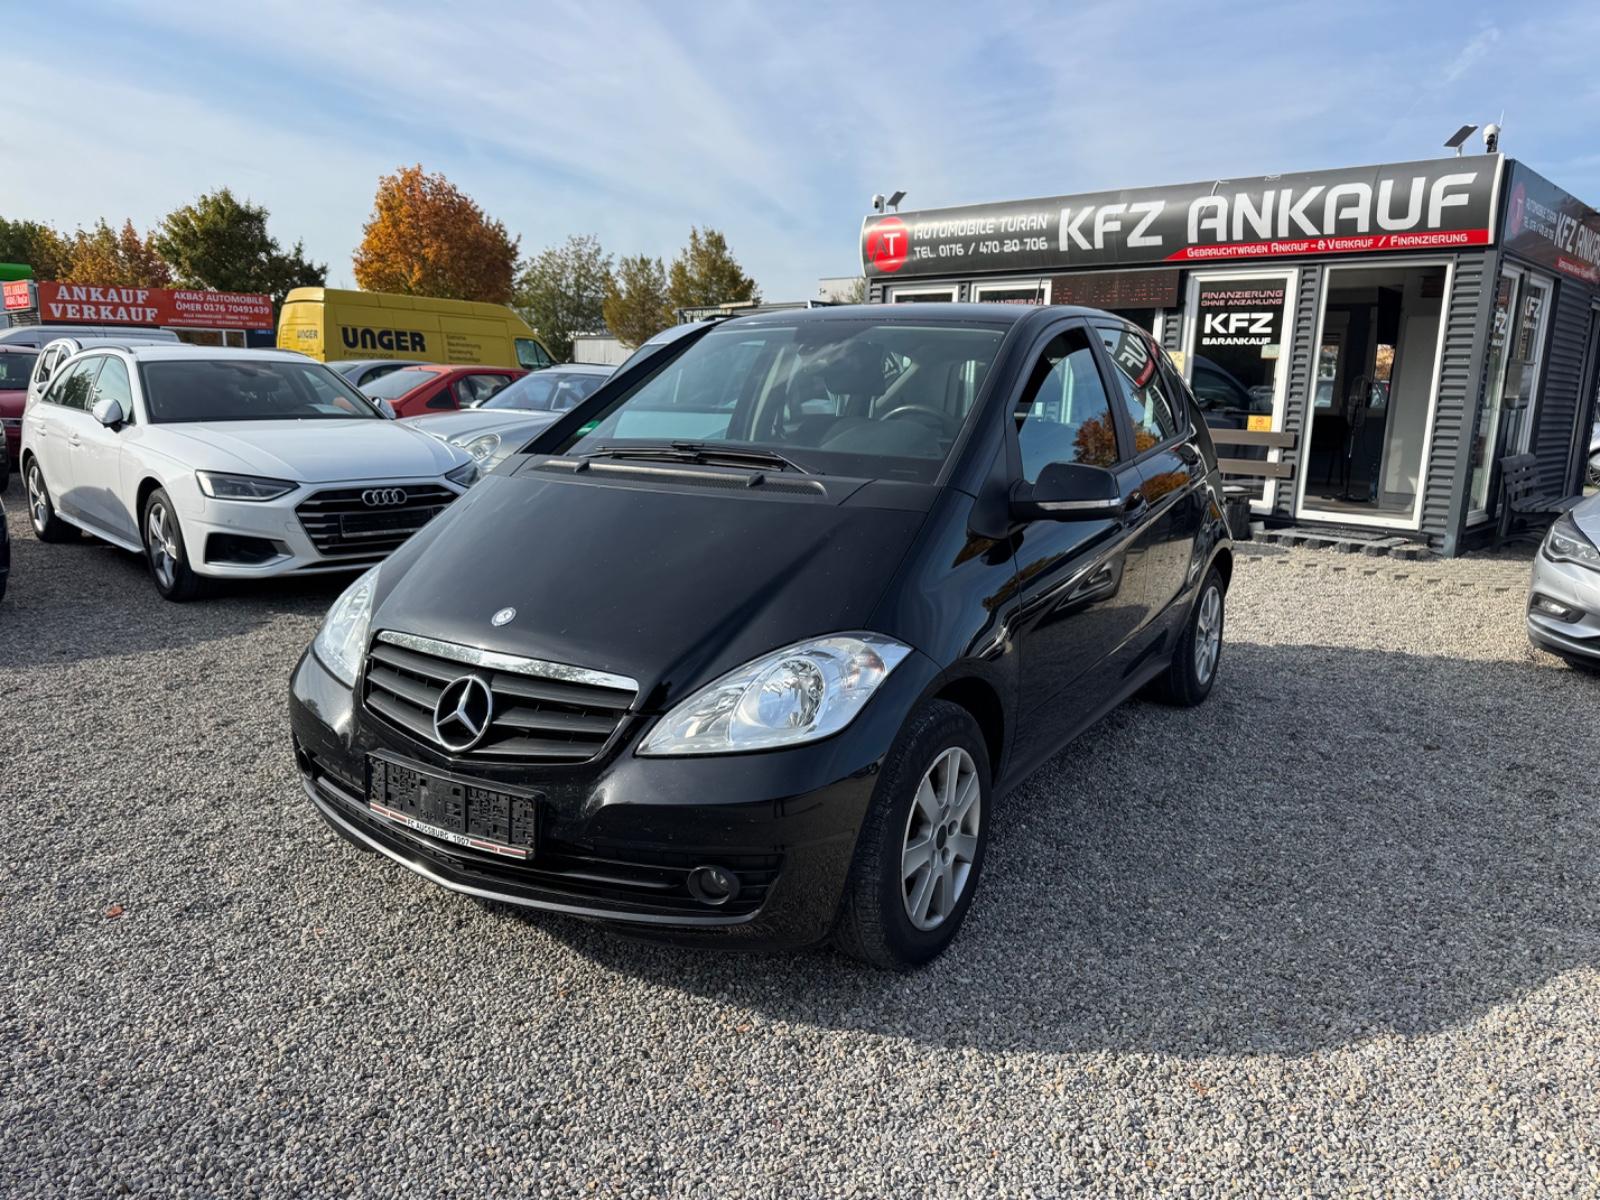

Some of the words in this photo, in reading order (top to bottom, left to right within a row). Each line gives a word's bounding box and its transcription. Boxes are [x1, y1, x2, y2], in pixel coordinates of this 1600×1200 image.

[1059, 200, 1166, 252] KFZ
[1187, 172, 1478, 244] ANKAUF
[913, 218, 995, 240] AUTOMOBILE
[1001, 214, 1049, 233] TURAN
[914, 246, 937, 260] TEL.
[939, 242, 965, 258] 0176
[979, 239, 1000, 254] 470
[1003, 238, 1021, 252] 20
[1024, 236, 1049, 251] 706
[56, 285, 150, 305] ANKAUF
[206, 294, 264, 305] AUTOMOBILE
[1201, 290, 1284, 299] FINANZIERUNG
[1227, 299, 1282, 307] ANZAHLUNG
[48, 303, 159, 322] VERKAUF
[175, 300, 202, 311] ÖMER
[203, 303, 226, 312] 0176
[1204, 312, 1274, 334] KFZ
[342, 327, 427, 353] UNGER
[1202, 337, 1271, 345] BARANKAUF
